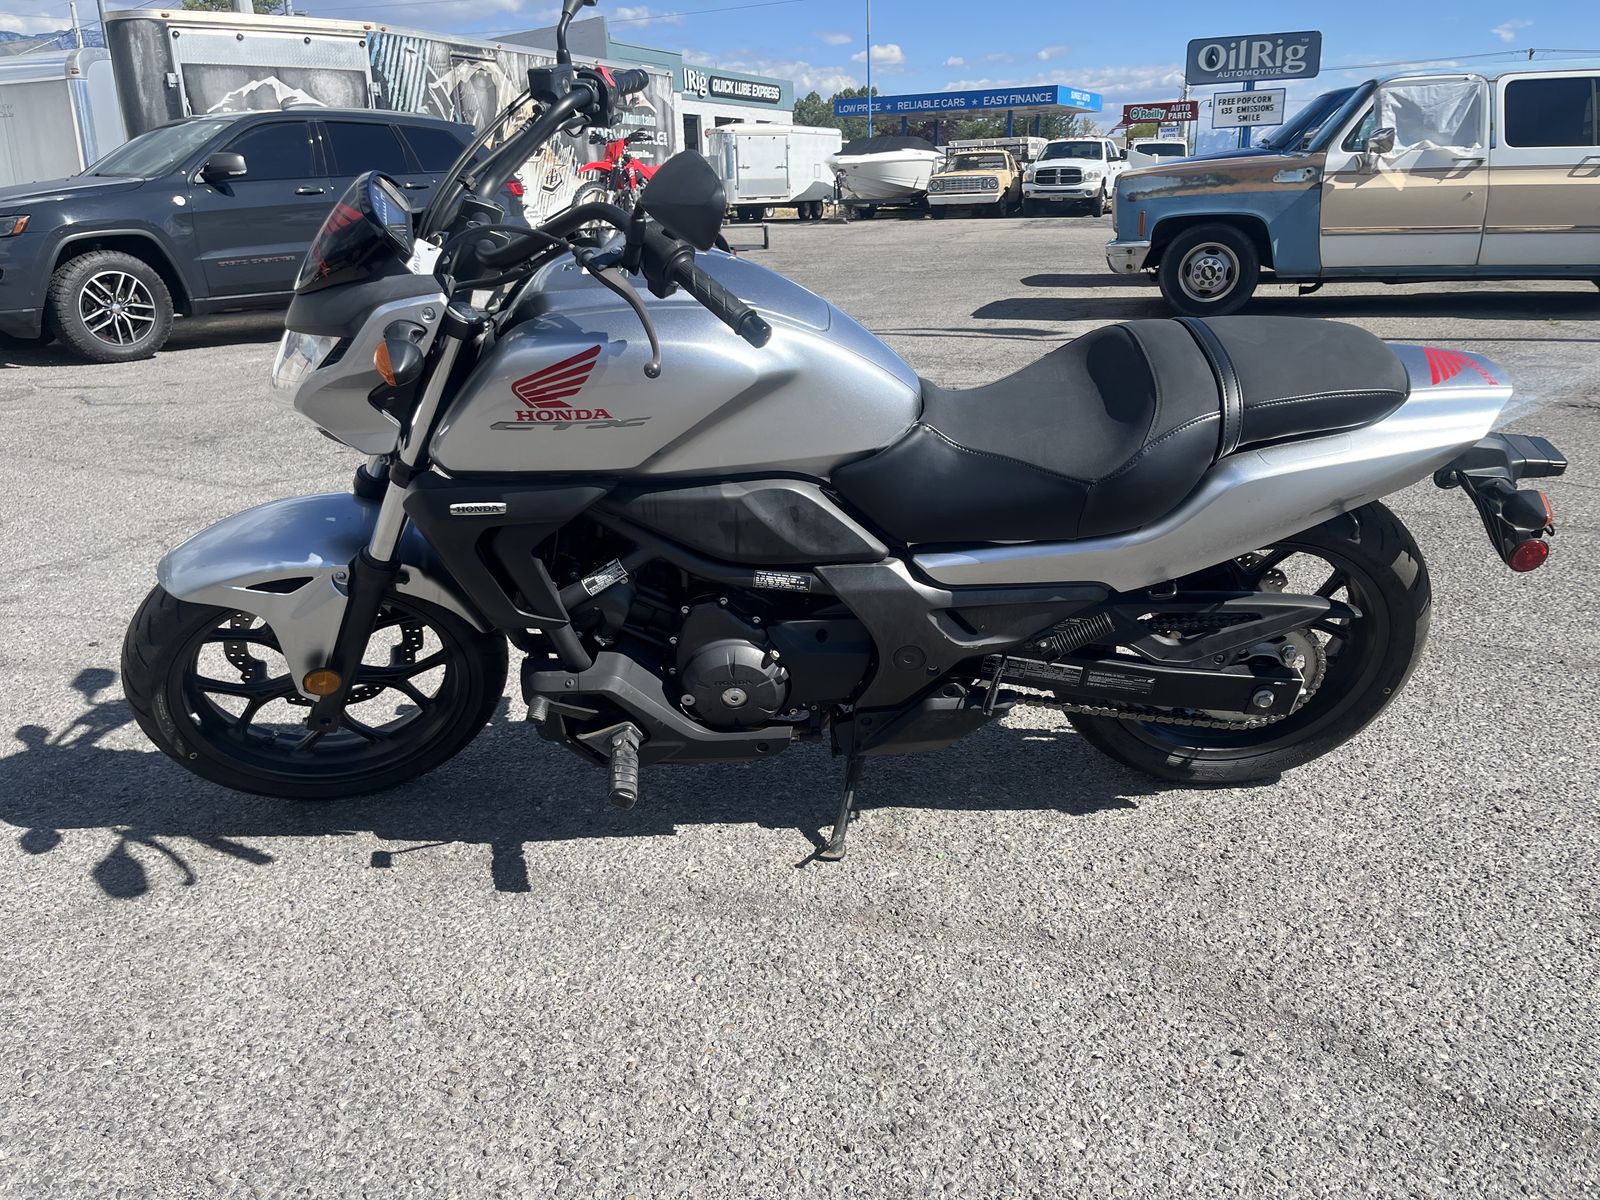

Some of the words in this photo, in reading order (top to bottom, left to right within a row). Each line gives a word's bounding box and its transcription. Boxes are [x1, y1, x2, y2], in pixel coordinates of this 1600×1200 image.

[1217, 67, 1281, 78] AUTOMOTIVE
[712, 79, 735, 94] QUICK
[734, 81, 752, 96] LUBE
[751, 84, 780, 100] EXPRESS
[838, 104, 856, 114] LOW
[856, 103, 882, 113] PRCE
[897, 99, 940, 110] RELIABLE
[941, 97, 965, 108] CARS
[983, 95, 1009, 106] EASY
[1009, 92, 1052, 104] FINANCE
[1218, 97, 1236, 106] FREE
[1130, 106, 1166, 120] O'Reilly
[1236, 104, 1274, 113] EMISSIONS
[622, 112, 656, 126] Mountain
[1168, 111, 1192, 119] PARTS
[1238, 114, 1260, 122] SMILE
[515, 408, 613, 421] HONDA
[456, 505, 500, 513] HONDA
